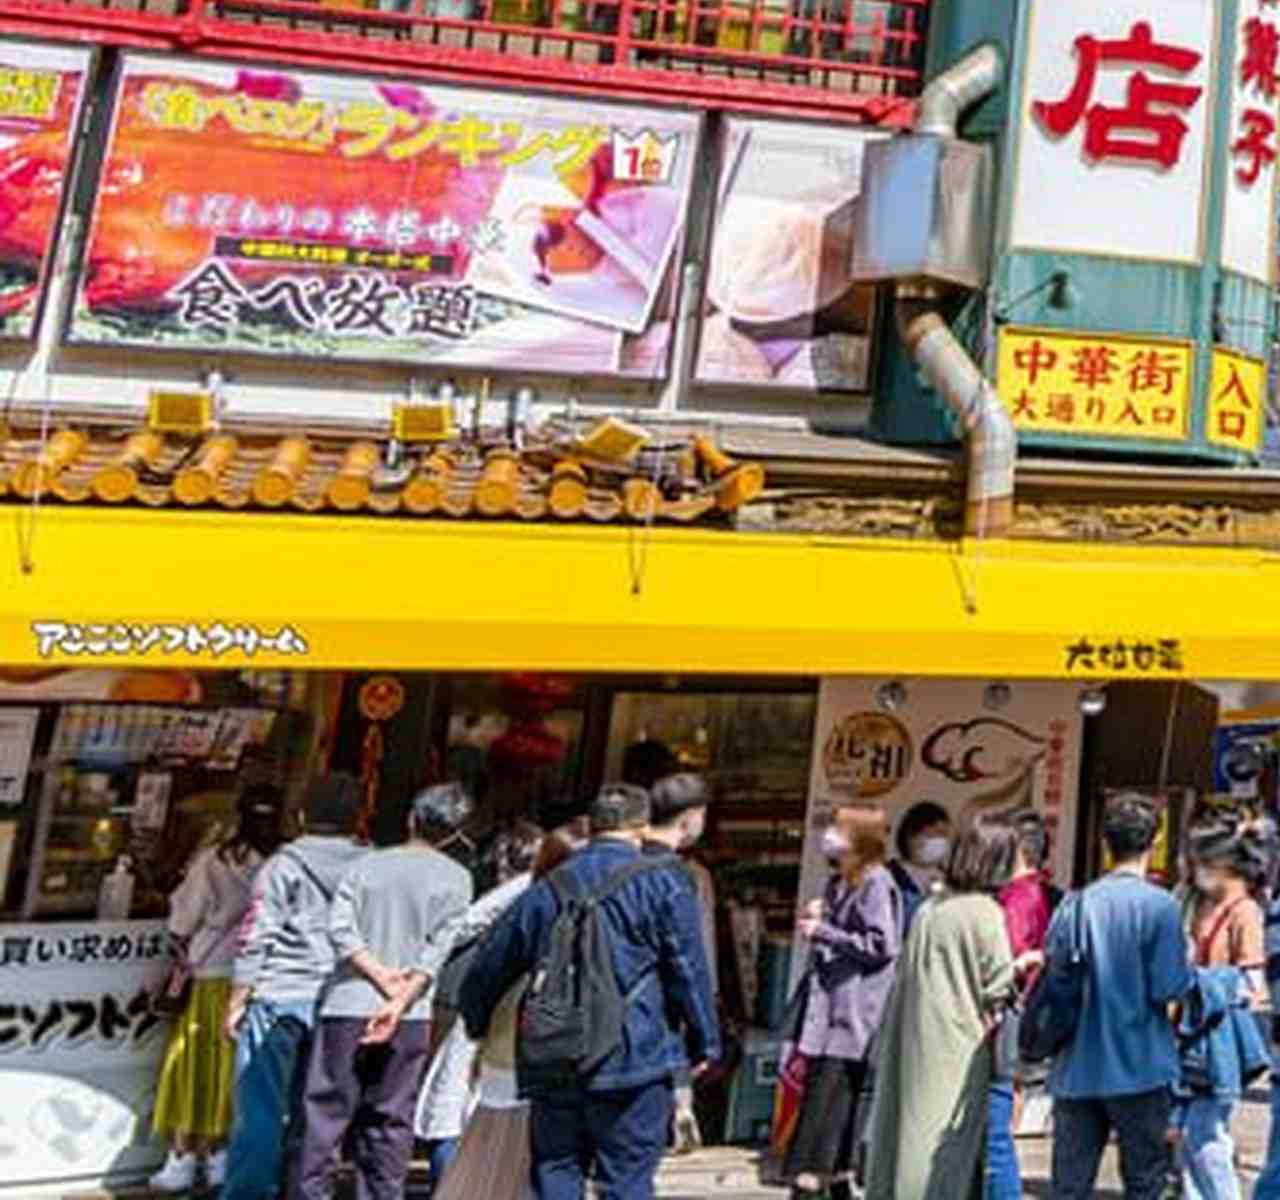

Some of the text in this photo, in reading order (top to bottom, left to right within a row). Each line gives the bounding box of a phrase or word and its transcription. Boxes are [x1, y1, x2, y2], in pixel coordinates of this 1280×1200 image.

[173, 261, 477, 341] 食べ放題
[1013, 340, 1182, 396] 中華街
[1013, 390, 1176, 426] 大通り入口
[1218, 363, 1252, 440] 入口
